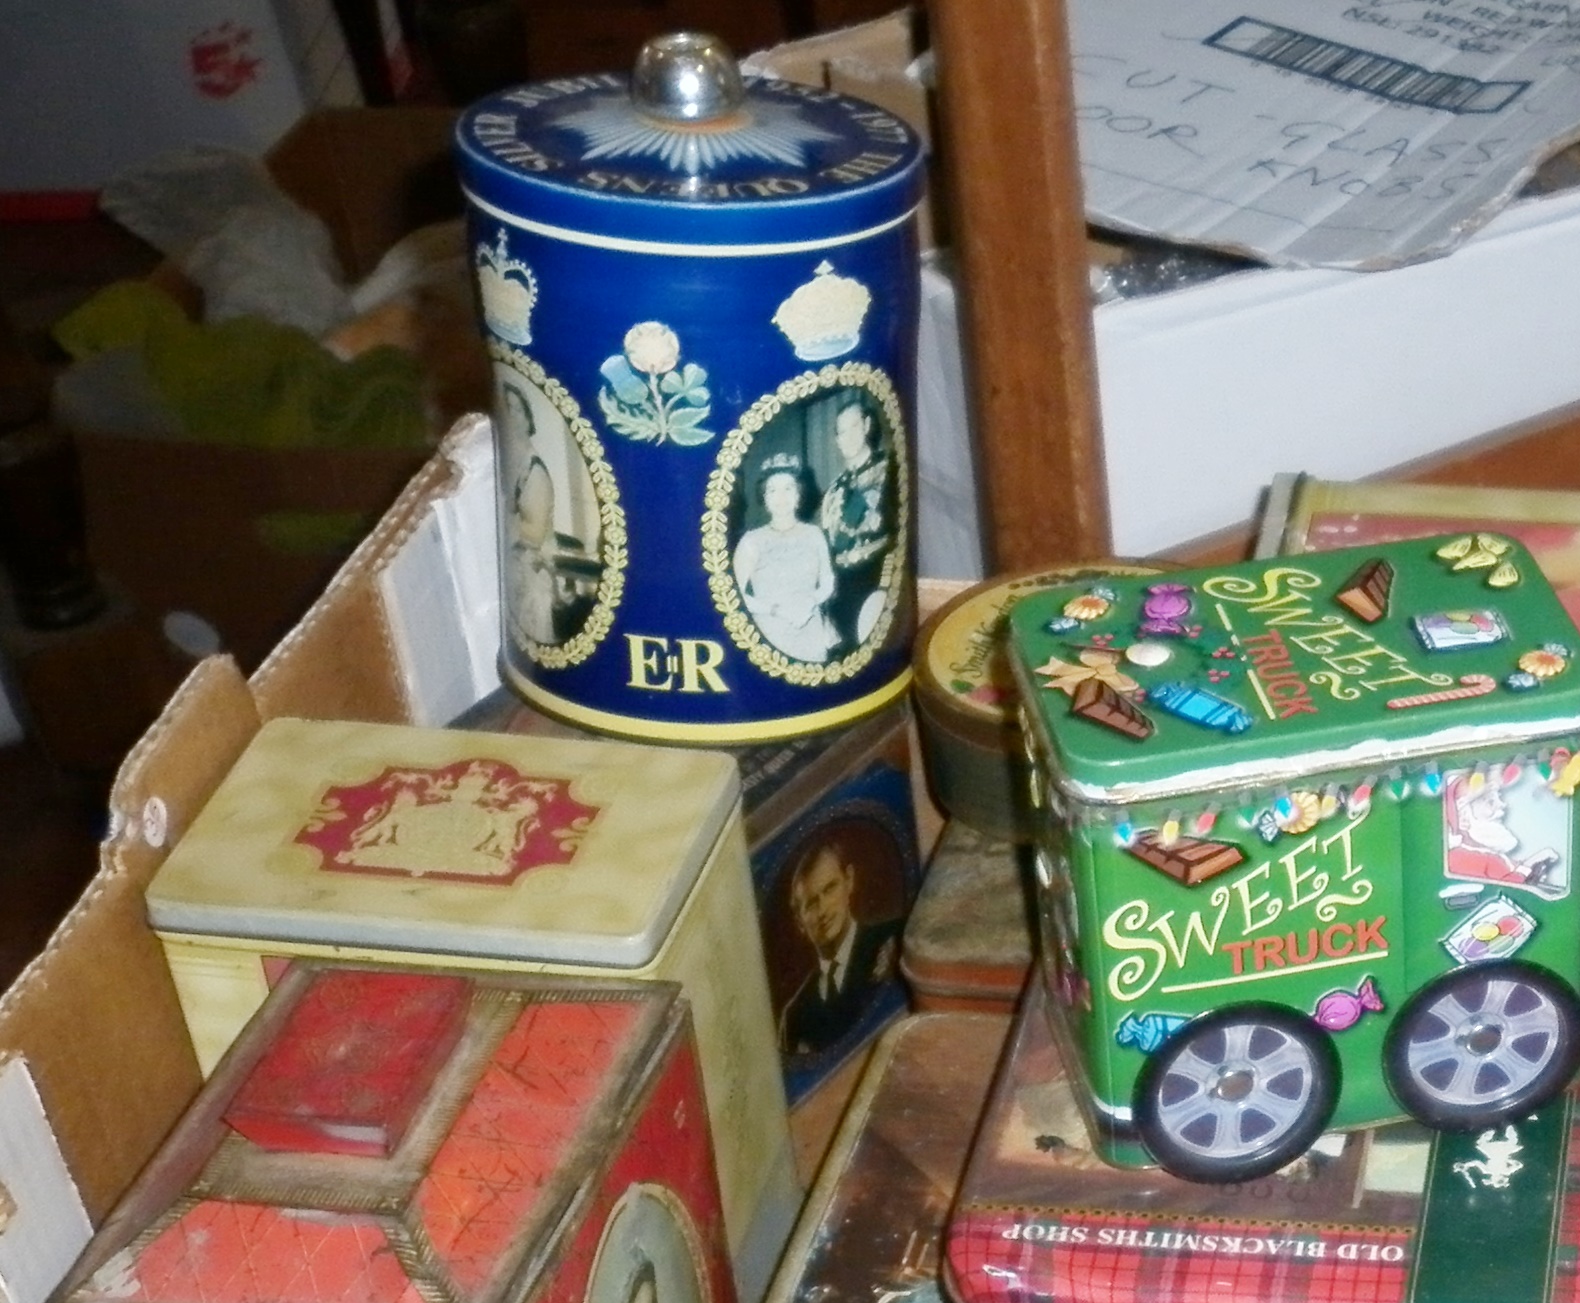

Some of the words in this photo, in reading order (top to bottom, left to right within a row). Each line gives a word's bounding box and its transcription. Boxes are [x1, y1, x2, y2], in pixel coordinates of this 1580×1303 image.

[1248, 157, 1478, 201] KNOBS
[1203, 567, 1453, 702] SWEET
[1241, 628, 1317, 720] TRUCK
[1102, 809, 1373, 1001] SWEET
[1222, 915, 1390, 977] TRUCK
[1002, 1222, 1088, 1245] SHOP
[1097, 1227, 1328, 1259] BLACKSMITHS
[1337, 1241, 1404, 1262] OLD
